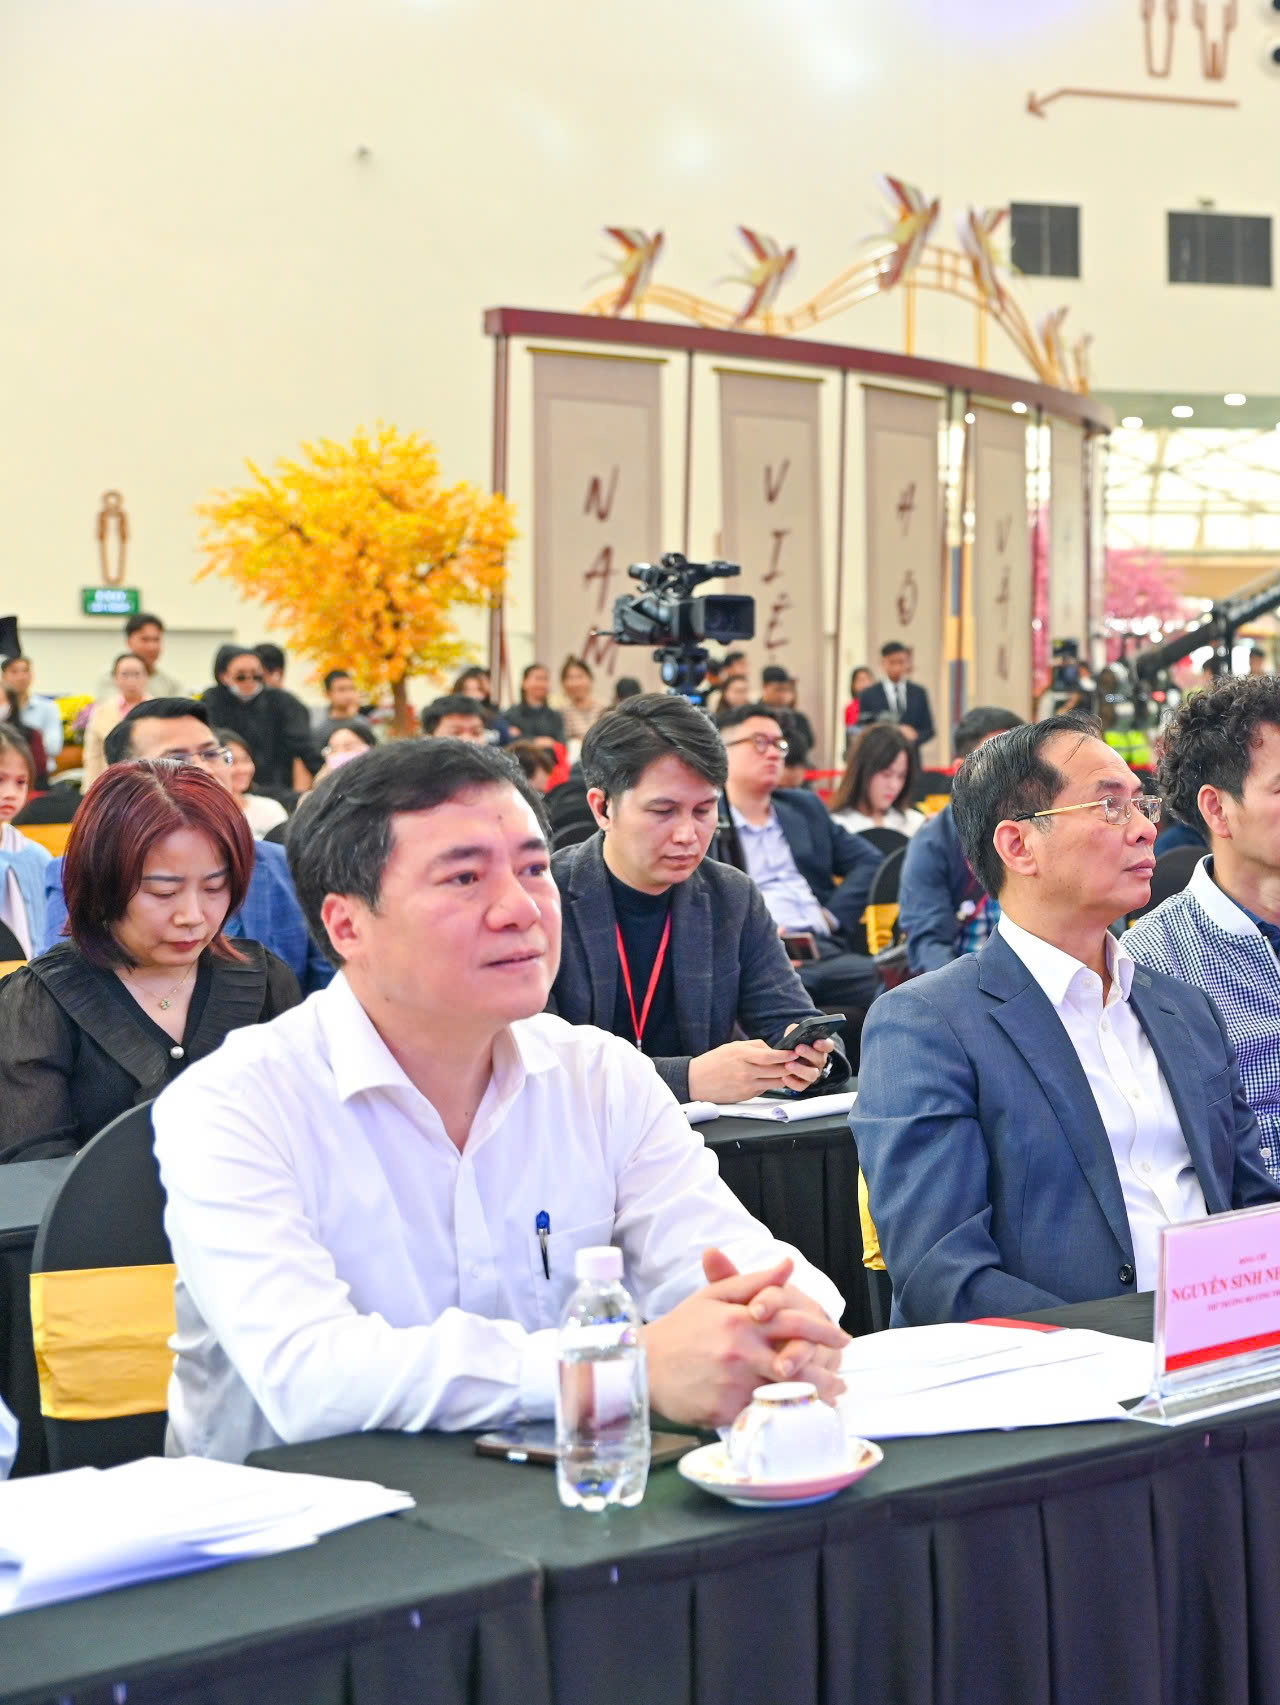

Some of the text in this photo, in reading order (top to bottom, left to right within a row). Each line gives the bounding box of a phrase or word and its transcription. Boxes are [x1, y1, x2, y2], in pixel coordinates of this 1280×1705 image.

[584, 464, 621, 676] NAM
[762, 458, 793, 664] VIỆ
[1230, 1270, 1263, 1290] SINH
